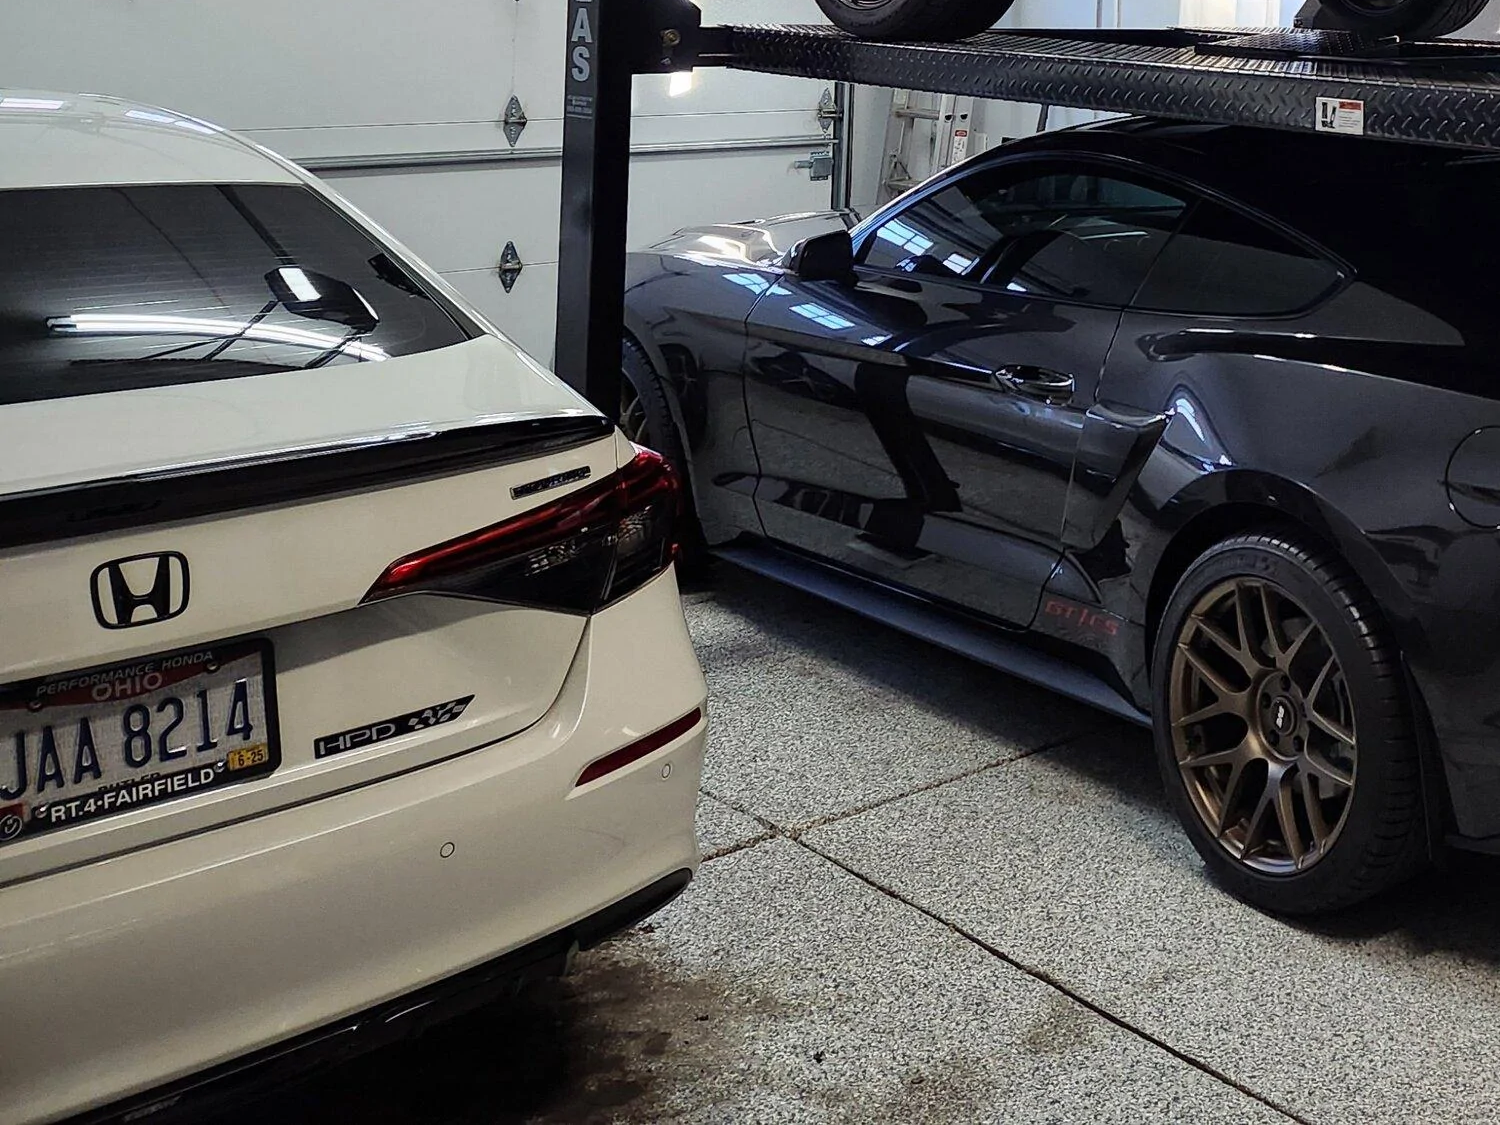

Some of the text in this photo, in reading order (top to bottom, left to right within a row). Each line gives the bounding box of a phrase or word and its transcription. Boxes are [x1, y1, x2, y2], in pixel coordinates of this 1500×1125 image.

[36, 651, 213, 697] PERFORMANCE HONDA
[92, 672, 163, 702] OHIO
[0, 677, 254, 801] JAA 8214
[319, 723, 396, 755] HPD
